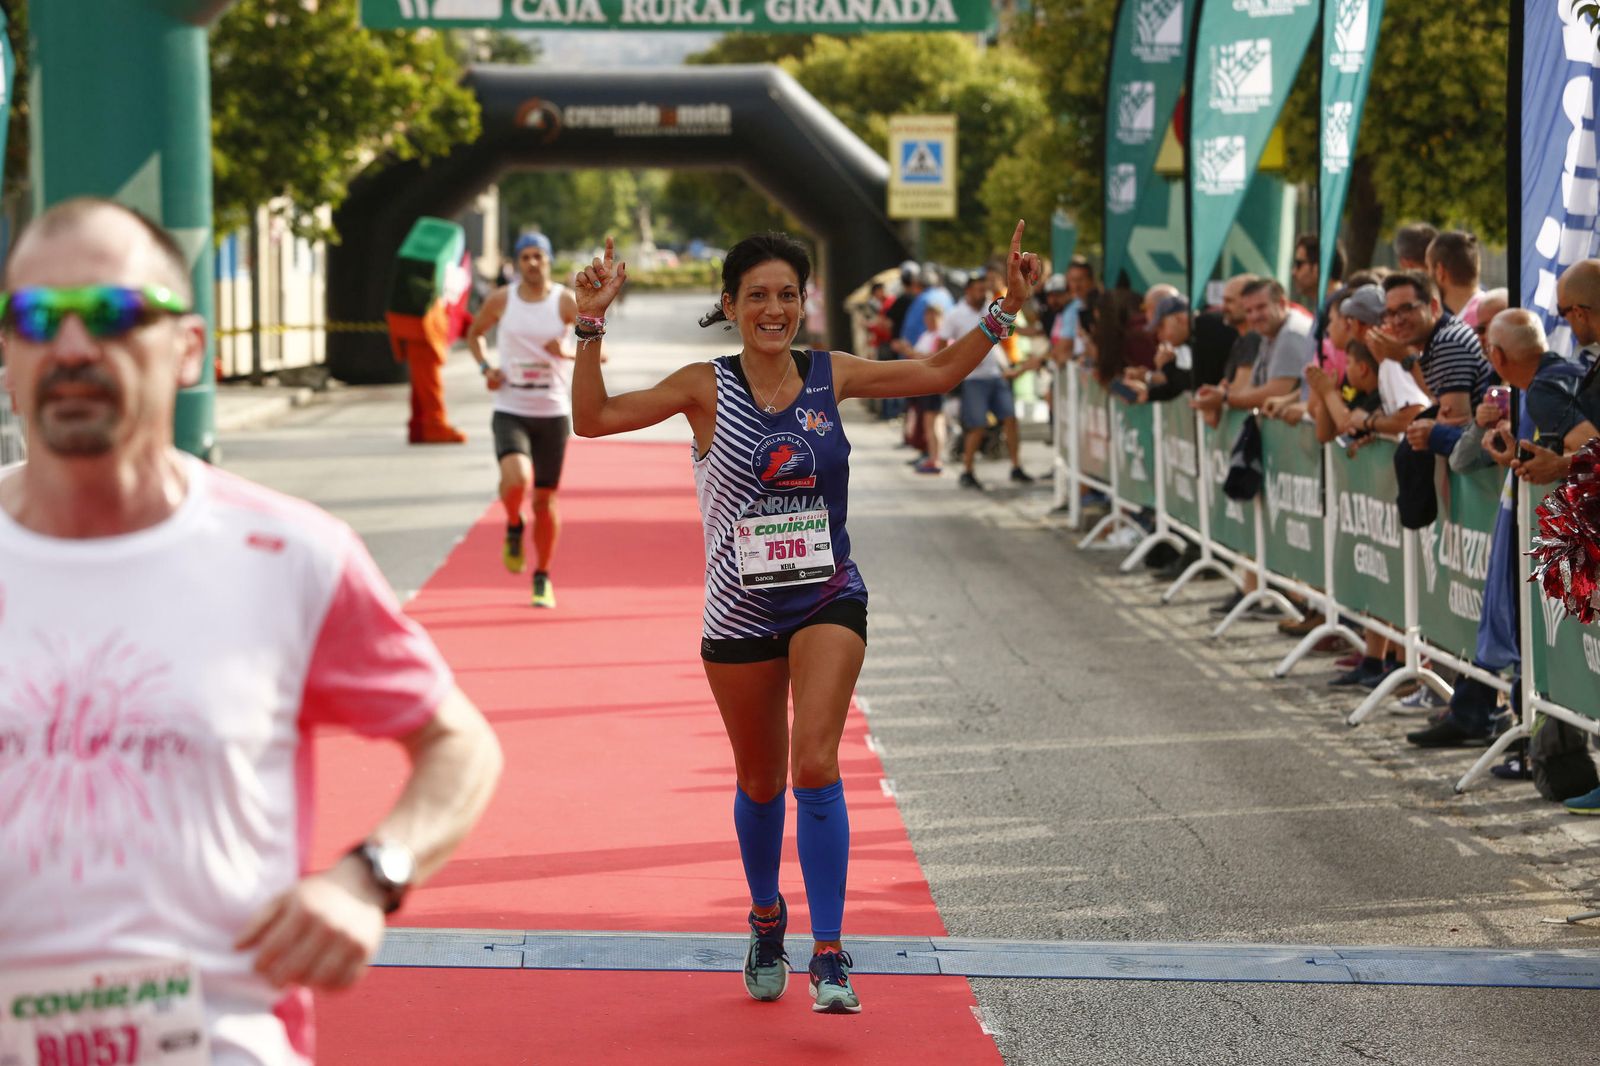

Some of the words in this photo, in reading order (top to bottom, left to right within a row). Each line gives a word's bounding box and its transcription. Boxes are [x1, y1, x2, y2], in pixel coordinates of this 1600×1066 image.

[511, 0, 607, 24] CAJA
[620, 0, 755, 24] RURAL
[765, 0, 959, 23] GRANADA
[759, 435, 786, 453] HUELLAS
[765, 537, 806, 561] 7576
[780, 562, 796, 570] KEILA
[35, 1024, 141, 1066] 8057
